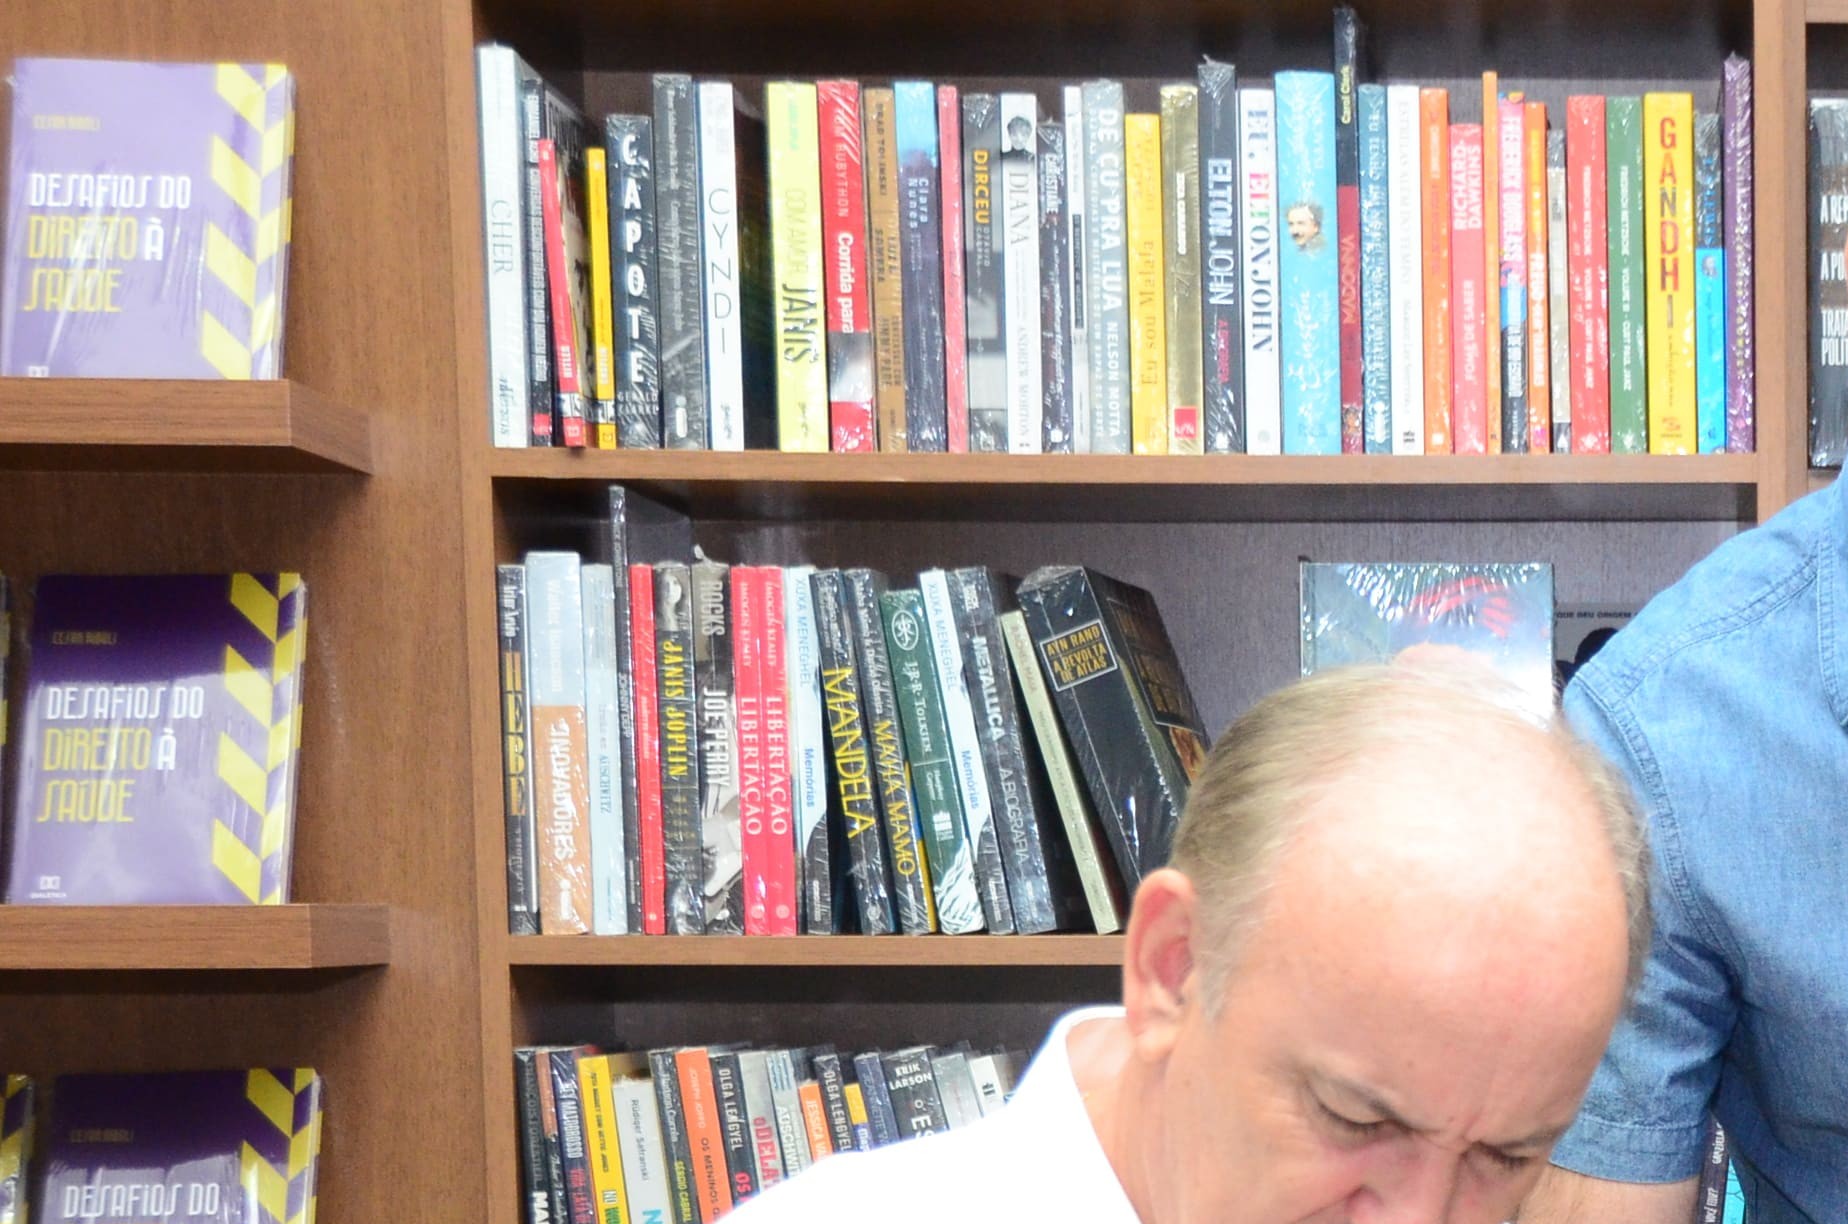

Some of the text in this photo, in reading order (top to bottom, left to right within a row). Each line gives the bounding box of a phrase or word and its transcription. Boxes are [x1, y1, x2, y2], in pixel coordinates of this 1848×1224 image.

[30, 172, 192, 210] DESAFIOS DO
[973, 149, 990, 225] DIRCEU
[1008, 171, 1032, 246] DIANA
[1097, 108, 1123, 312] DE CU PRA LUA
[1467, 144, 1482, 230] DAWKINS
[1658, 116, 1681, 329] GANDHI
[143, 216, 164, 262] À
[490, 199, 515, 275] CHER
[621, 133, 646, 386] CAPOTE
[707, 188, 732, 355] CYNDI
[1207, 157, 1234, 305] ELTON JOHN
[836, 231, 856, 333] Corrida para
[1341, 233, 1356, 325] MADONNA
[782, 283, 818, 364] JANIS
[1463, 279, 1476, 381] FOME DE SABER
[1106, 321, 1121, 437] NELSON MOTTA
[700, 578, 726, 636] ROCKS
[1046, 625, 1101, 657] AYN RAND
[46, 685, 206, 720] DESAFIOS DO
[661, 640, 688, 777] JANIS JOPLIN
[972, 635, 1005, 741] METALLICA
[1060, 654, 1107, 684] DE ATLAS
[42, 727, 177, 772] DIREITO À
[703, 686, 731, 788] JOE PERRY
[822, 665, 875, 839] MANDELA
[37, 778, 136, 823] SAÚDE
[718, 1068, 743, 1152] OLGA LENGYEL
[889, 1072, 933, 1091] LARSON
[895, 1064, 921, 1077] ERIK
[63, 1182, 220, 1219] DESAFIOS DO
[602, 1189, 617, 1204] NO
